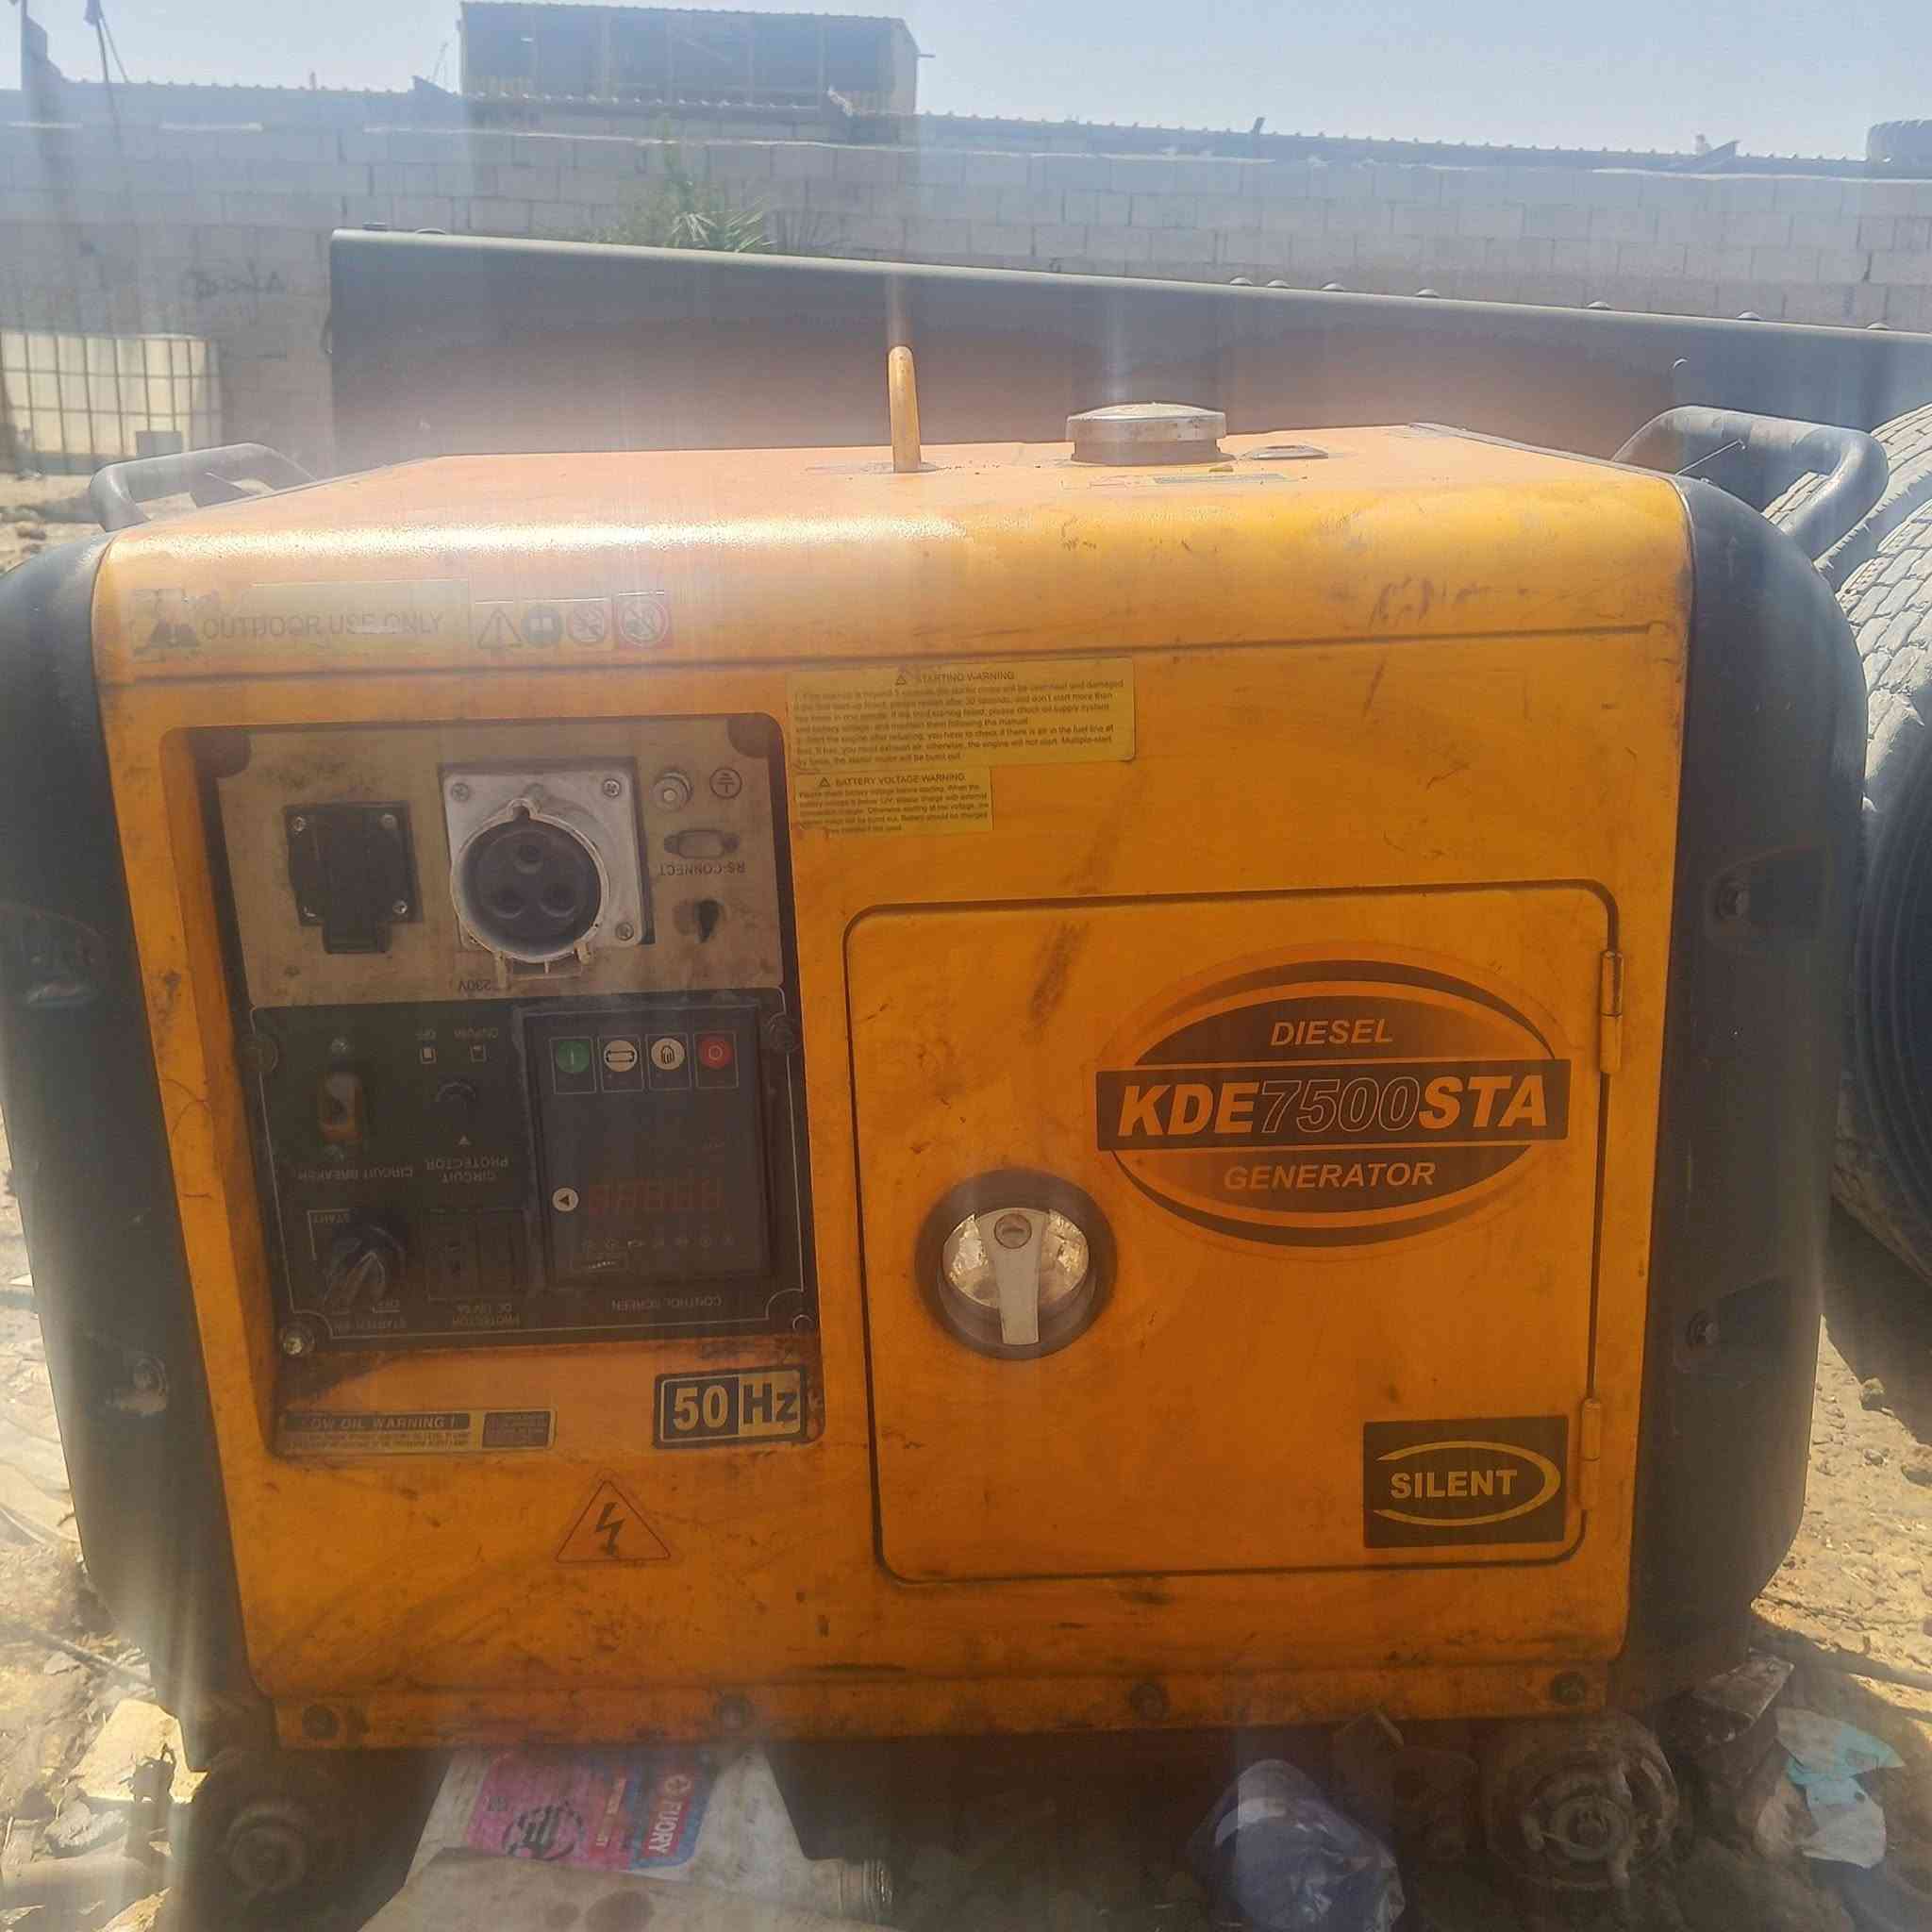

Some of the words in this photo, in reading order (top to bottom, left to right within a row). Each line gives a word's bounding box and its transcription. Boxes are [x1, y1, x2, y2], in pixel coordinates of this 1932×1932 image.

[329, 610, 375, 635] USE
[1270, 1018, 1393, 1047] DIESEL
[1118, 1074, 1548, 1137] KDE7500STA
[425, 1155, 509, 1171] PROTECTOR
[1224, 1161, 1438, 1191] GENERATOR
[440, 1170, 497, 1184] CIRCUIT
[372, 1414, 445, 1429] WARNING
[1390, 1469, 1518, 1499] SILENT
